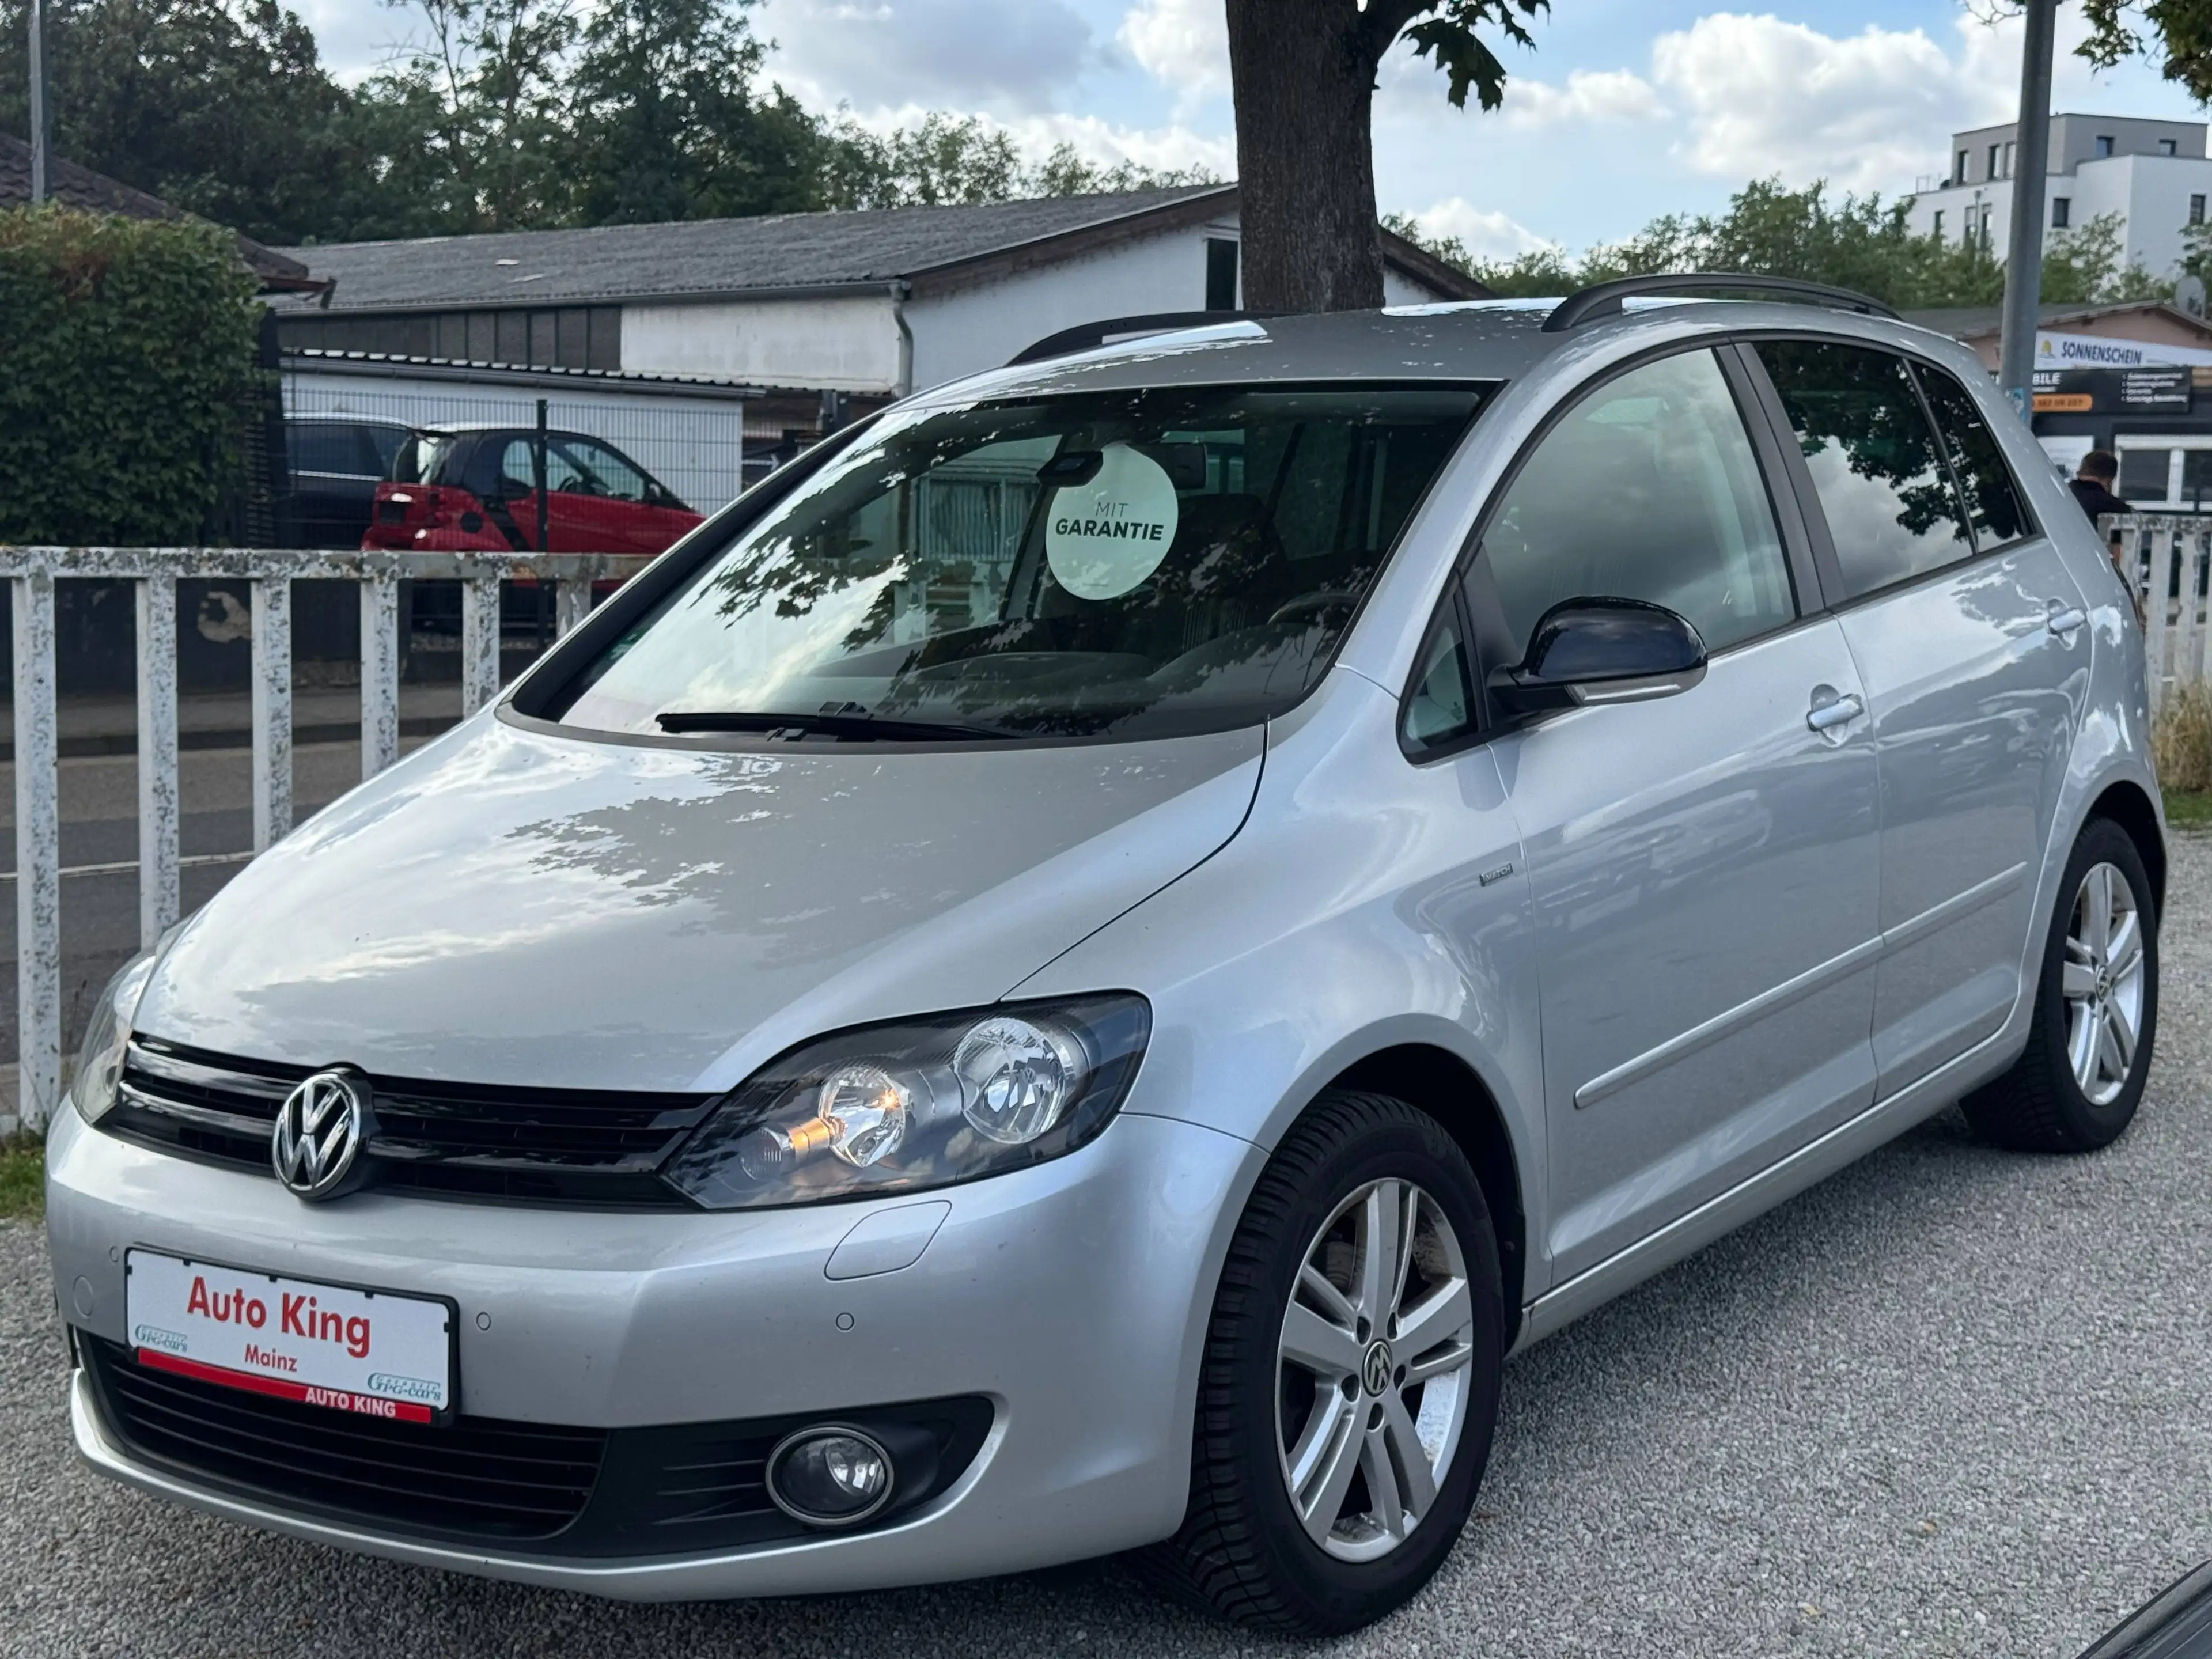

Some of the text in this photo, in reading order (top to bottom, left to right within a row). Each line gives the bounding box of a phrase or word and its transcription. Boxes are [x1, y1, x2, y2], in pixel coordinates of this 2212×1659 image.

[2061, 340, 2143, 364] SONNENSCHEIN
[1095, 502, 1129, 518] MIT
[1055, 518, 1164, 541] GARANTIE
[273, 1073, 361, 1196] VW
[187, 1276, 371, 1358] Auto King
[244, 1343, 298, 1373] Mainz
[304, 1387, 396, 1418] AUTO KING
